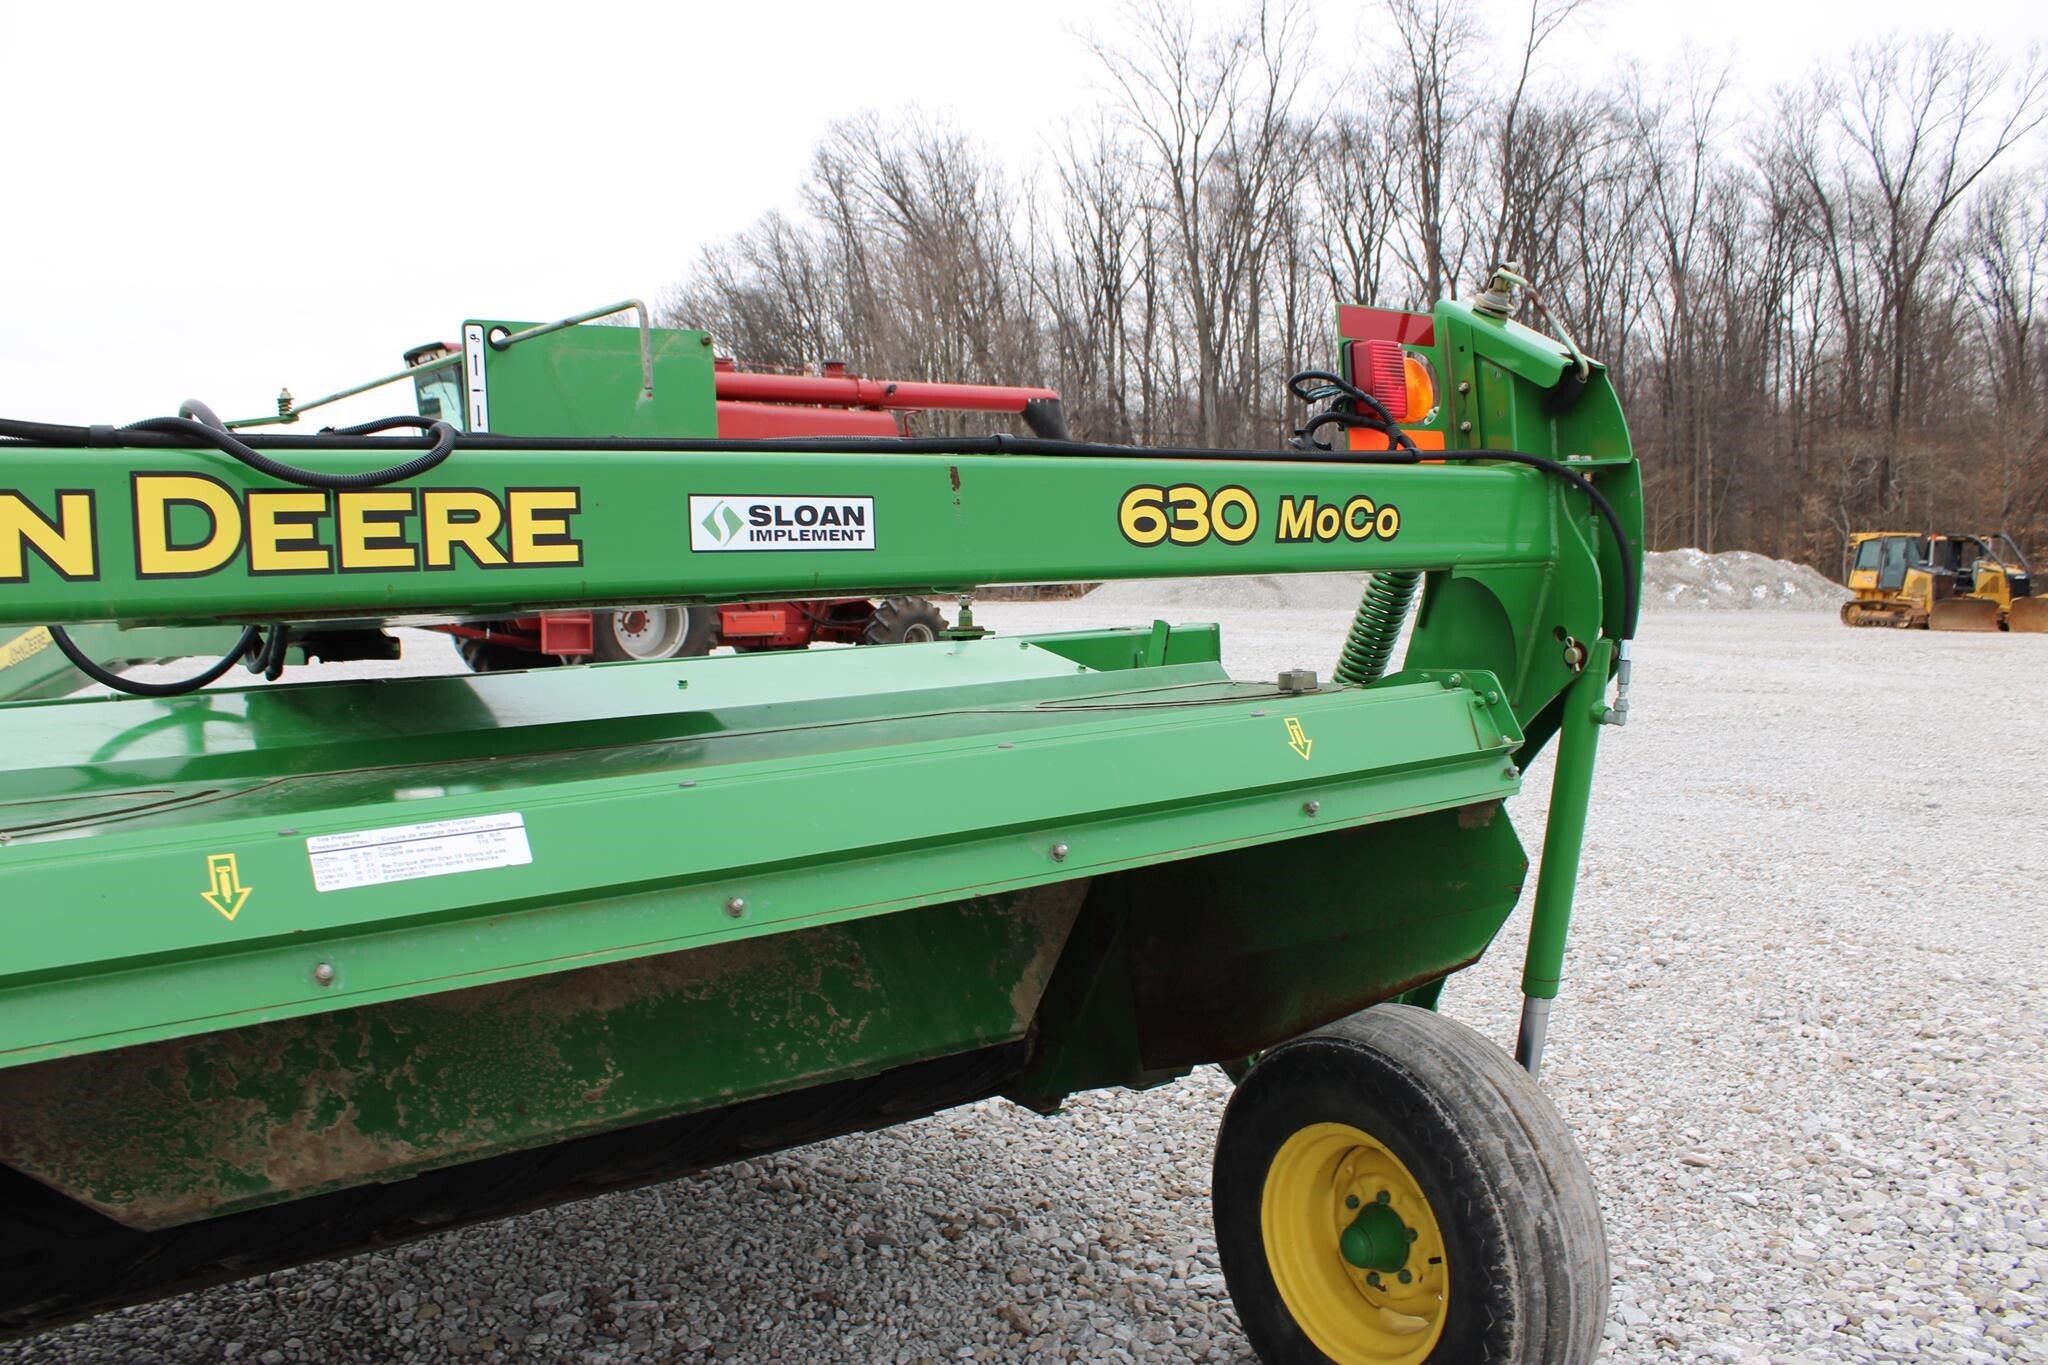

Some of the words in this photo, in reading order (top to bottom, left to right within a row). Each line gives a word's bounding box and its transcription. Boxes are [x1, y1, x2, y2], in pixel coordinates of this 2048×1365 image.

[130, 470, 584, 580] DEERE
[748, 504, 866, 527] SLOAN
[749, 529, 867, 542] IMPLEMENT
[1117, 483, 1260, 548] 630
